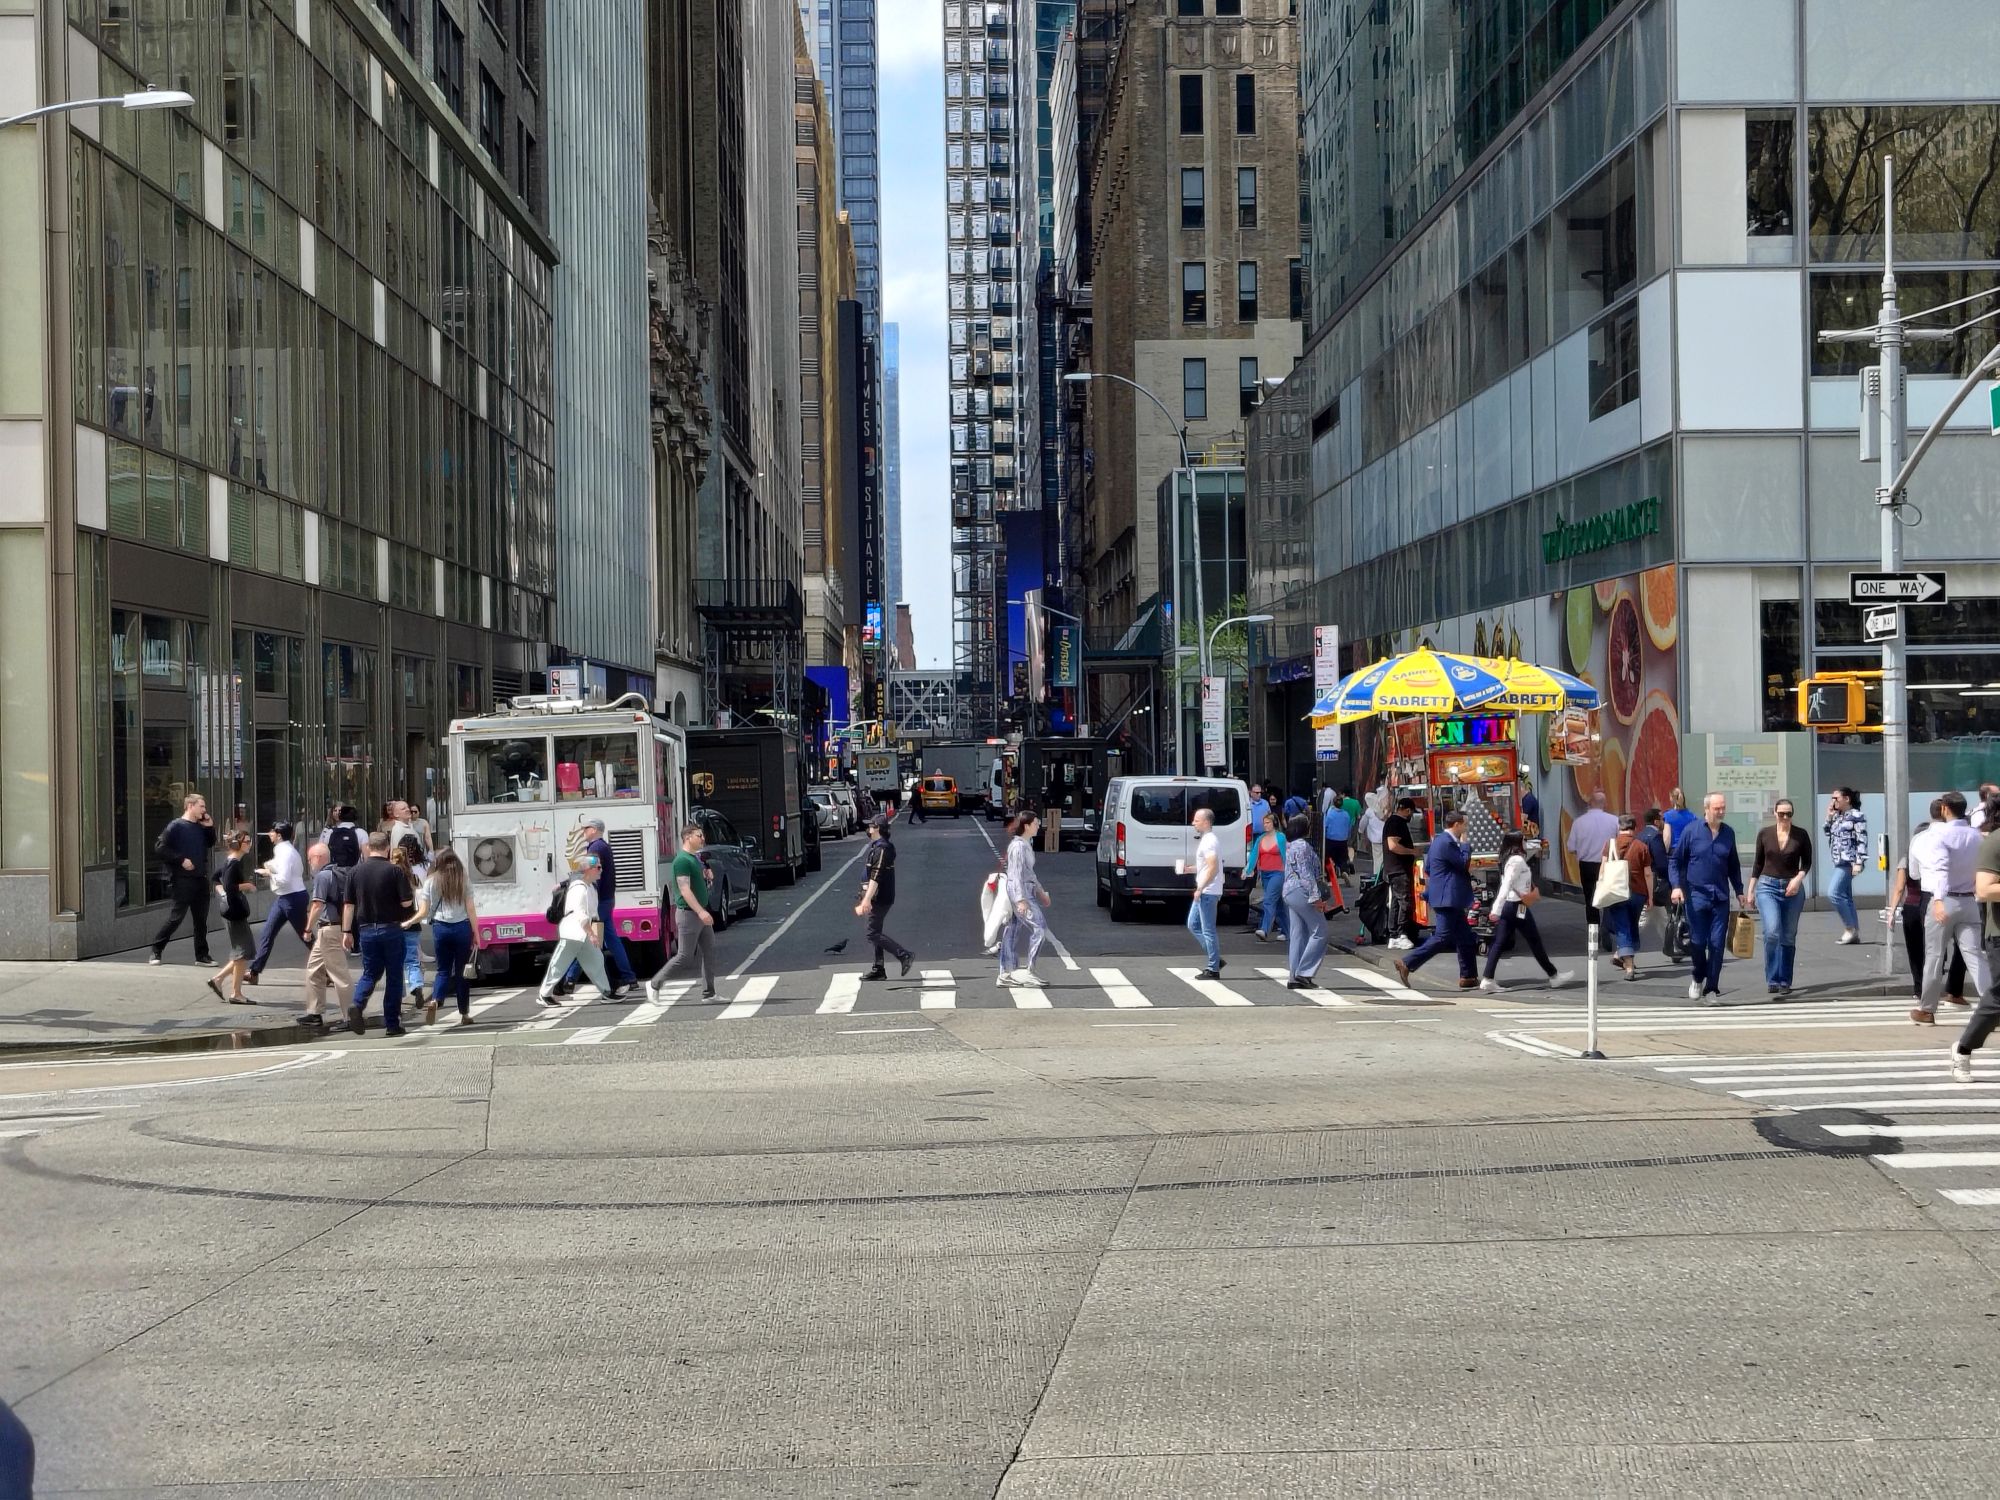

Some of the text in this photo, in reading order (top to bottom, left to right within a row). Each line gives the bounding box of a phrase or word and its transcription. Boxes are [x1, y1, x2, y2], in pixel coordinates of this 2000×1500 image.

[862, 346, 871, 437] TIMES
[1860, 582, 1927, 594] ONE WAY
[1870, 615, 1893, 631] ONE WAY
[1378, 695, 1451, 707] SABRETT
